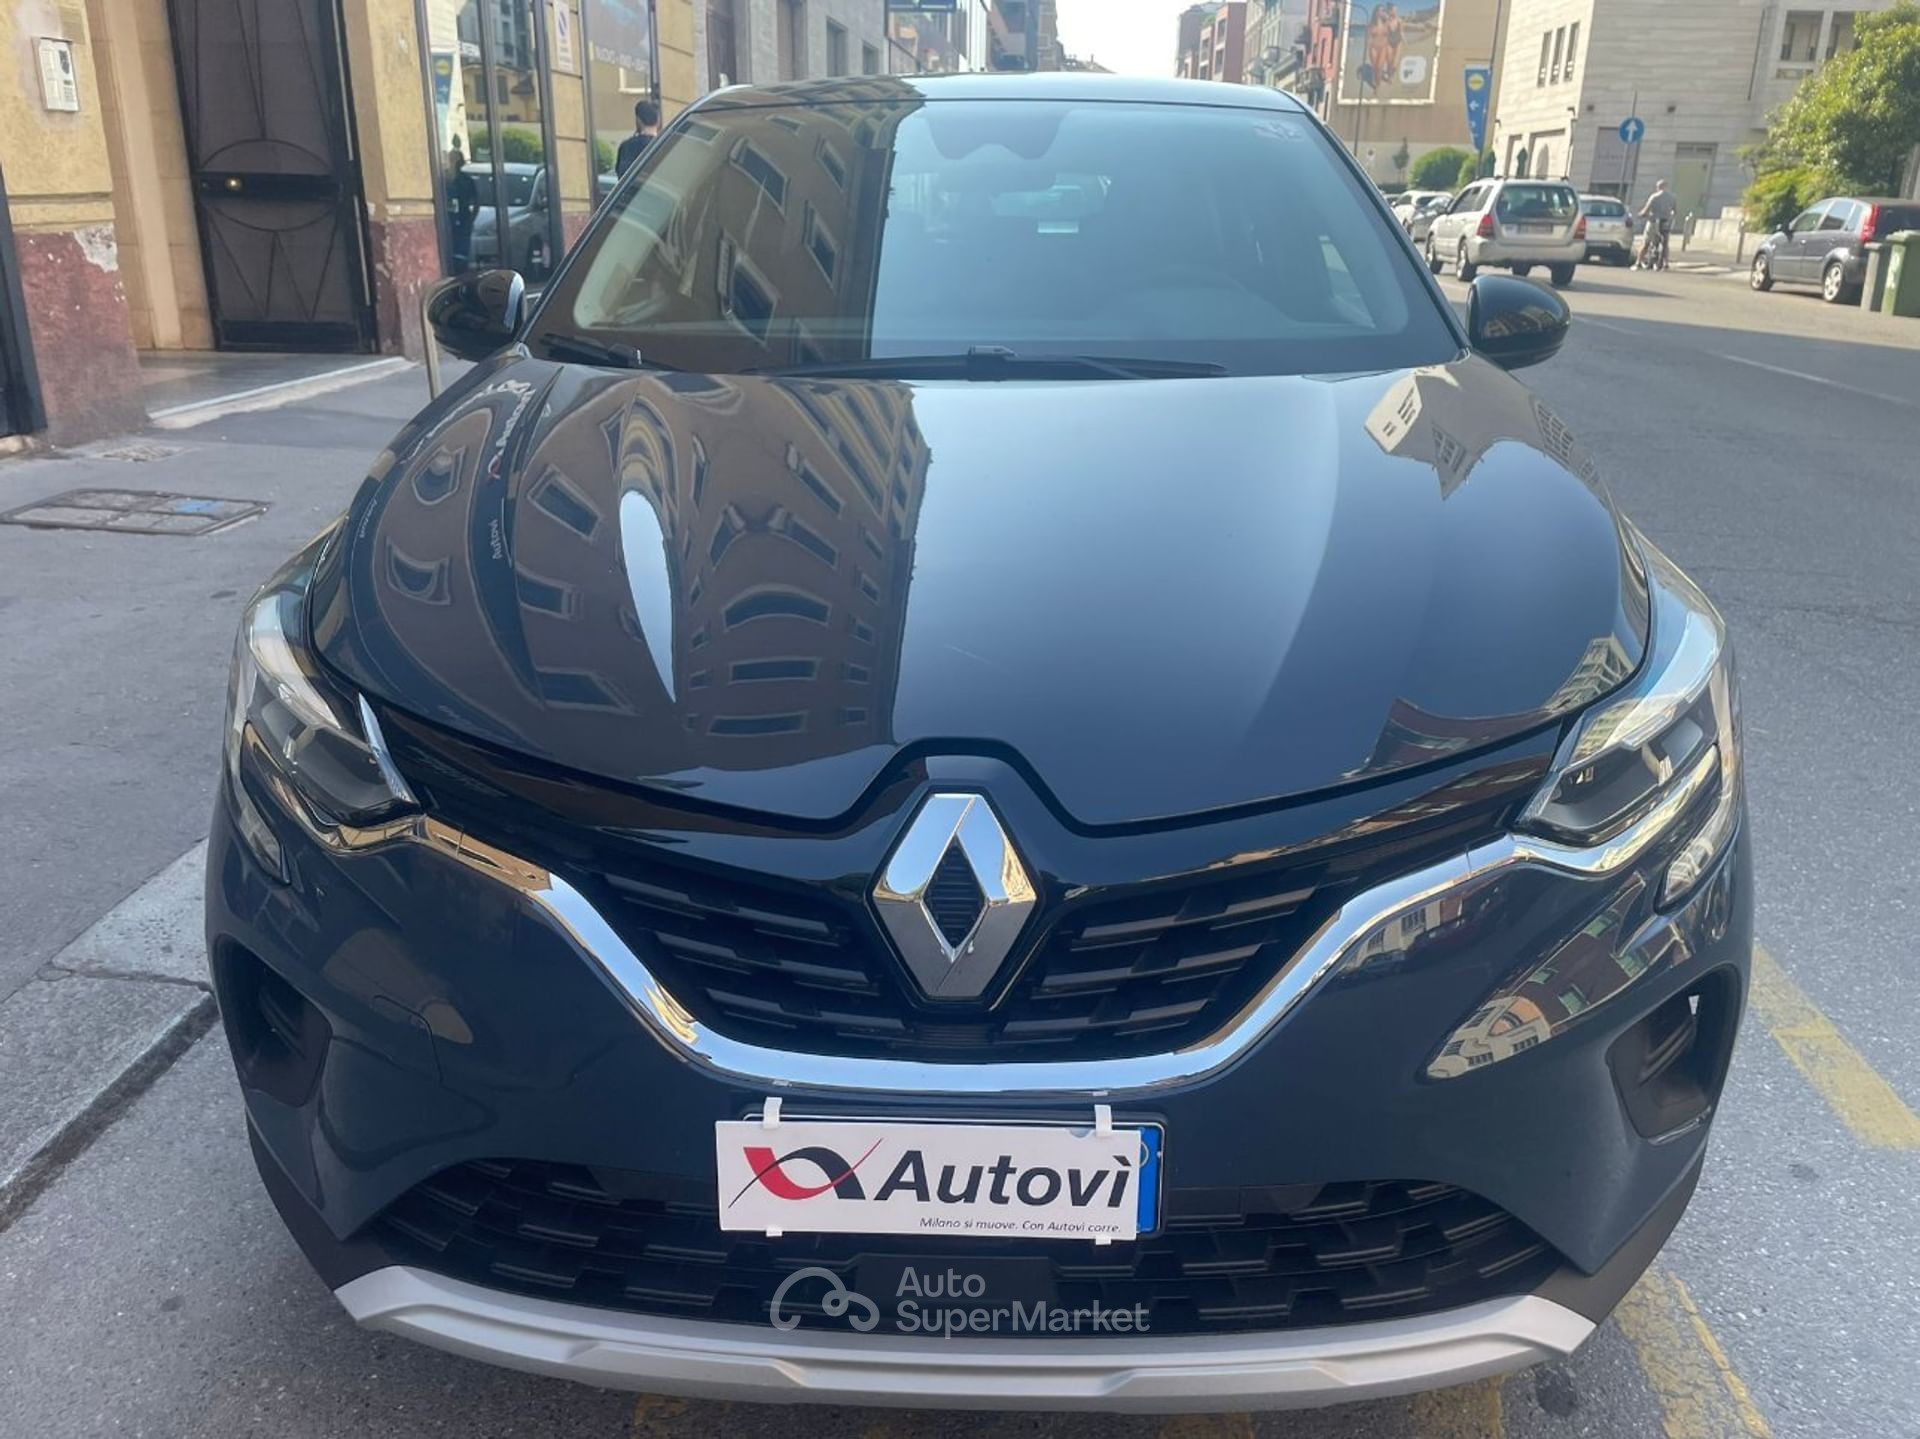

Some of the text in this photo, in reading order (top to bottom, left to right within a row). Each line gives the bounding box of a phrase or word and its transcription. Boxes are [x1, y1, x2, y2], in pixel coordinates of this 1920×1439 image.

[873, 1149, 1132, 1208] Autovì
[919, 1217, 960, 1229] Milano
[964, 1218, 973, 1229] si
[975, 1220, 1018, 1230] muove.
[1022, 1220, 1044, 1231] Con
[1088, 1223, 1121, 1233] corre.
